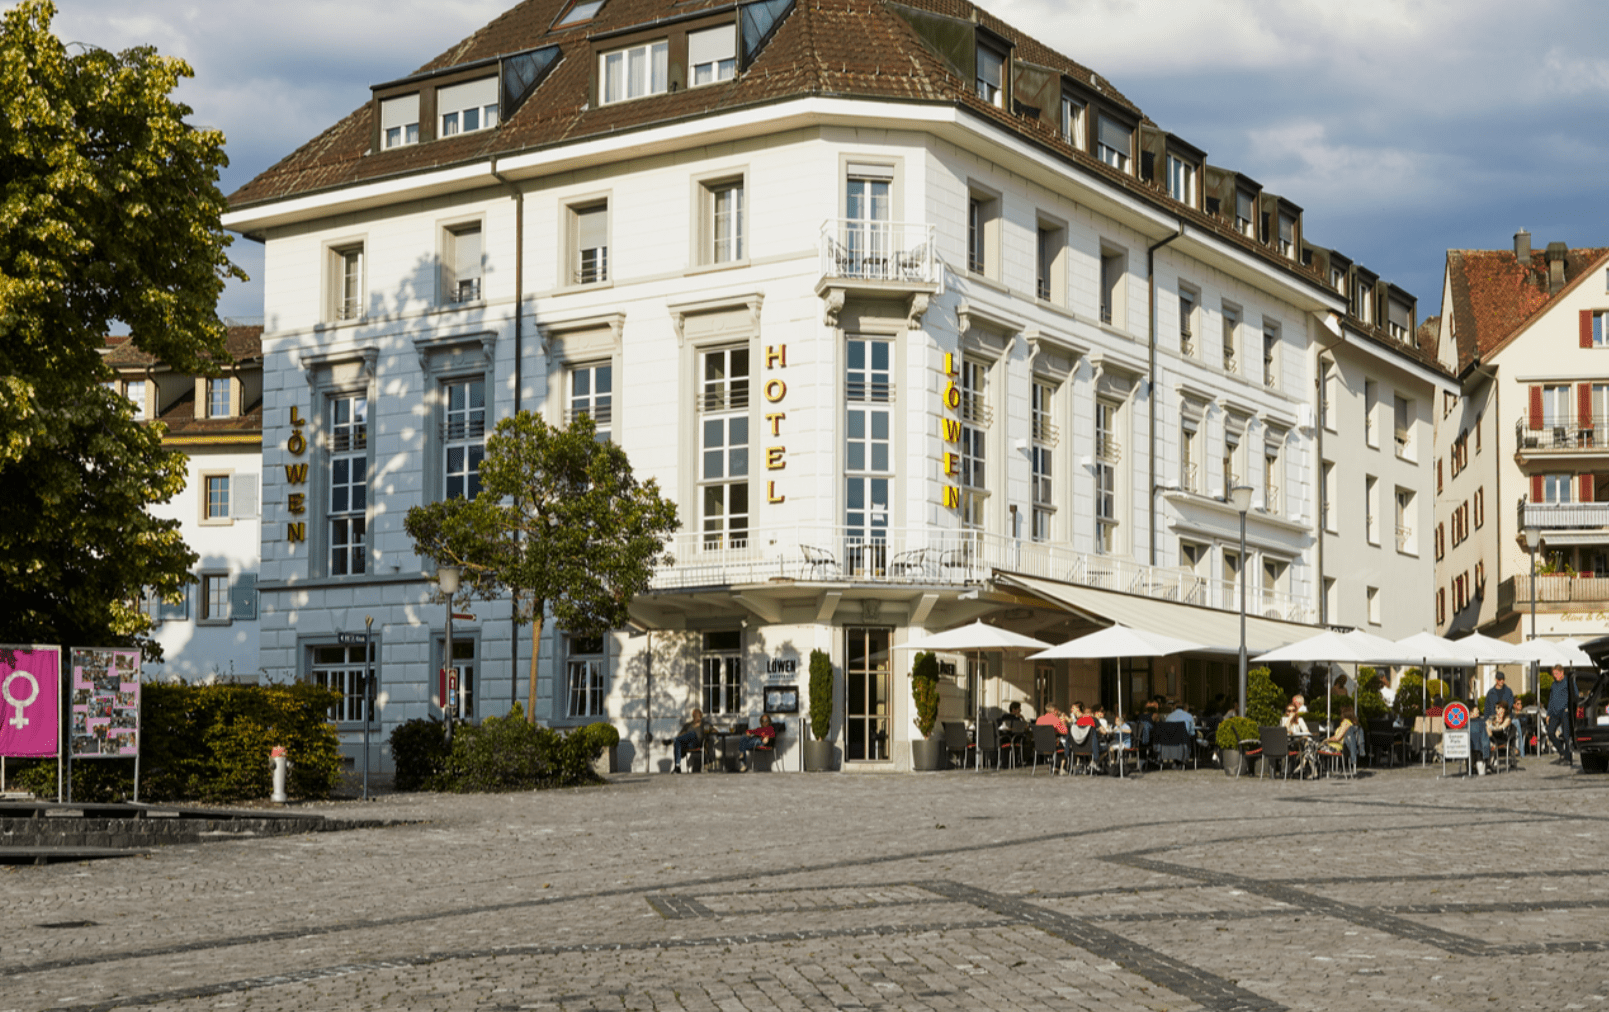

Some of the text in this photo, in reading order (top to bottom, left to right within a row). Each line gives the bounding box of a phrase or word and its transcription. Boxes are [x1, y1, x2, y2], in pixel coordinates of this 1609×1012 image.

[284, 405, 309, 543] LÖWEN
[764, 344, 787, 505] HOTEL
[942, 352, 962, 509] LÖWEN
[766, 657, 796, 673] LÖWEN
